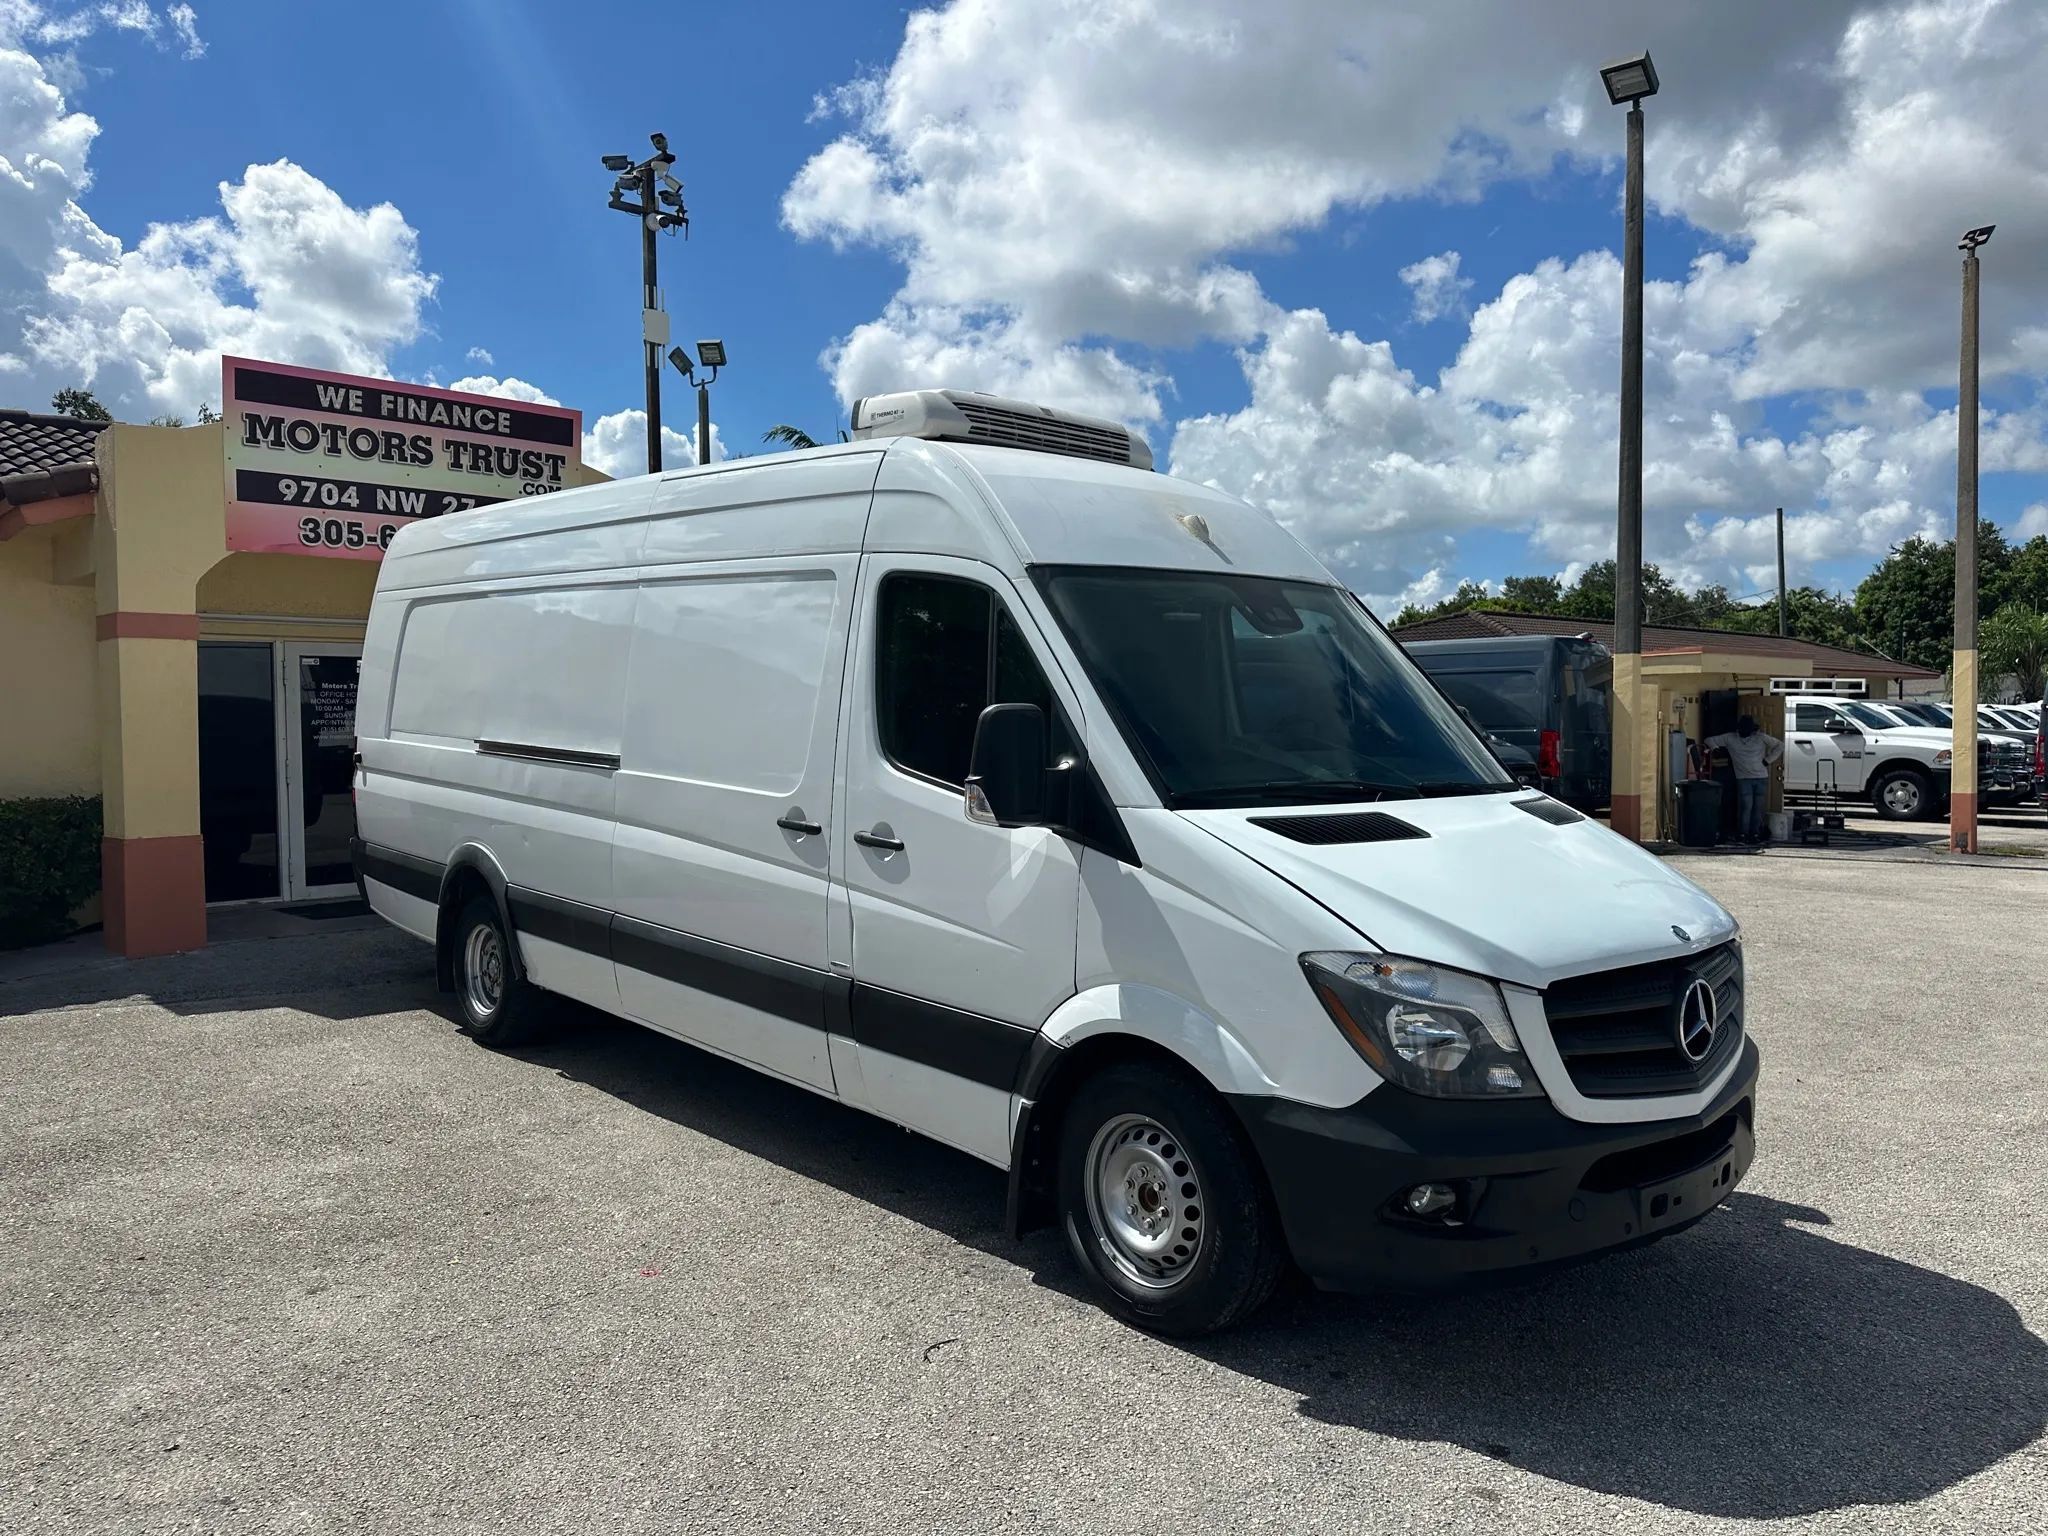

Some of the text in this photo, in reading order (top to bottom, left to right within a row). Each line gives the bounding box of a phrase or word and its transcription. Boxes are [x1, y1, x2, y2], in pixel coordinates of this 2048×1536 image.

[316, 384, 511, 434] WE FINANCE
[241, 412, 566, 483] MOTORS TRUST
[277, 478, 360, 508] 9704
[376, 488, 427, 515] NW
